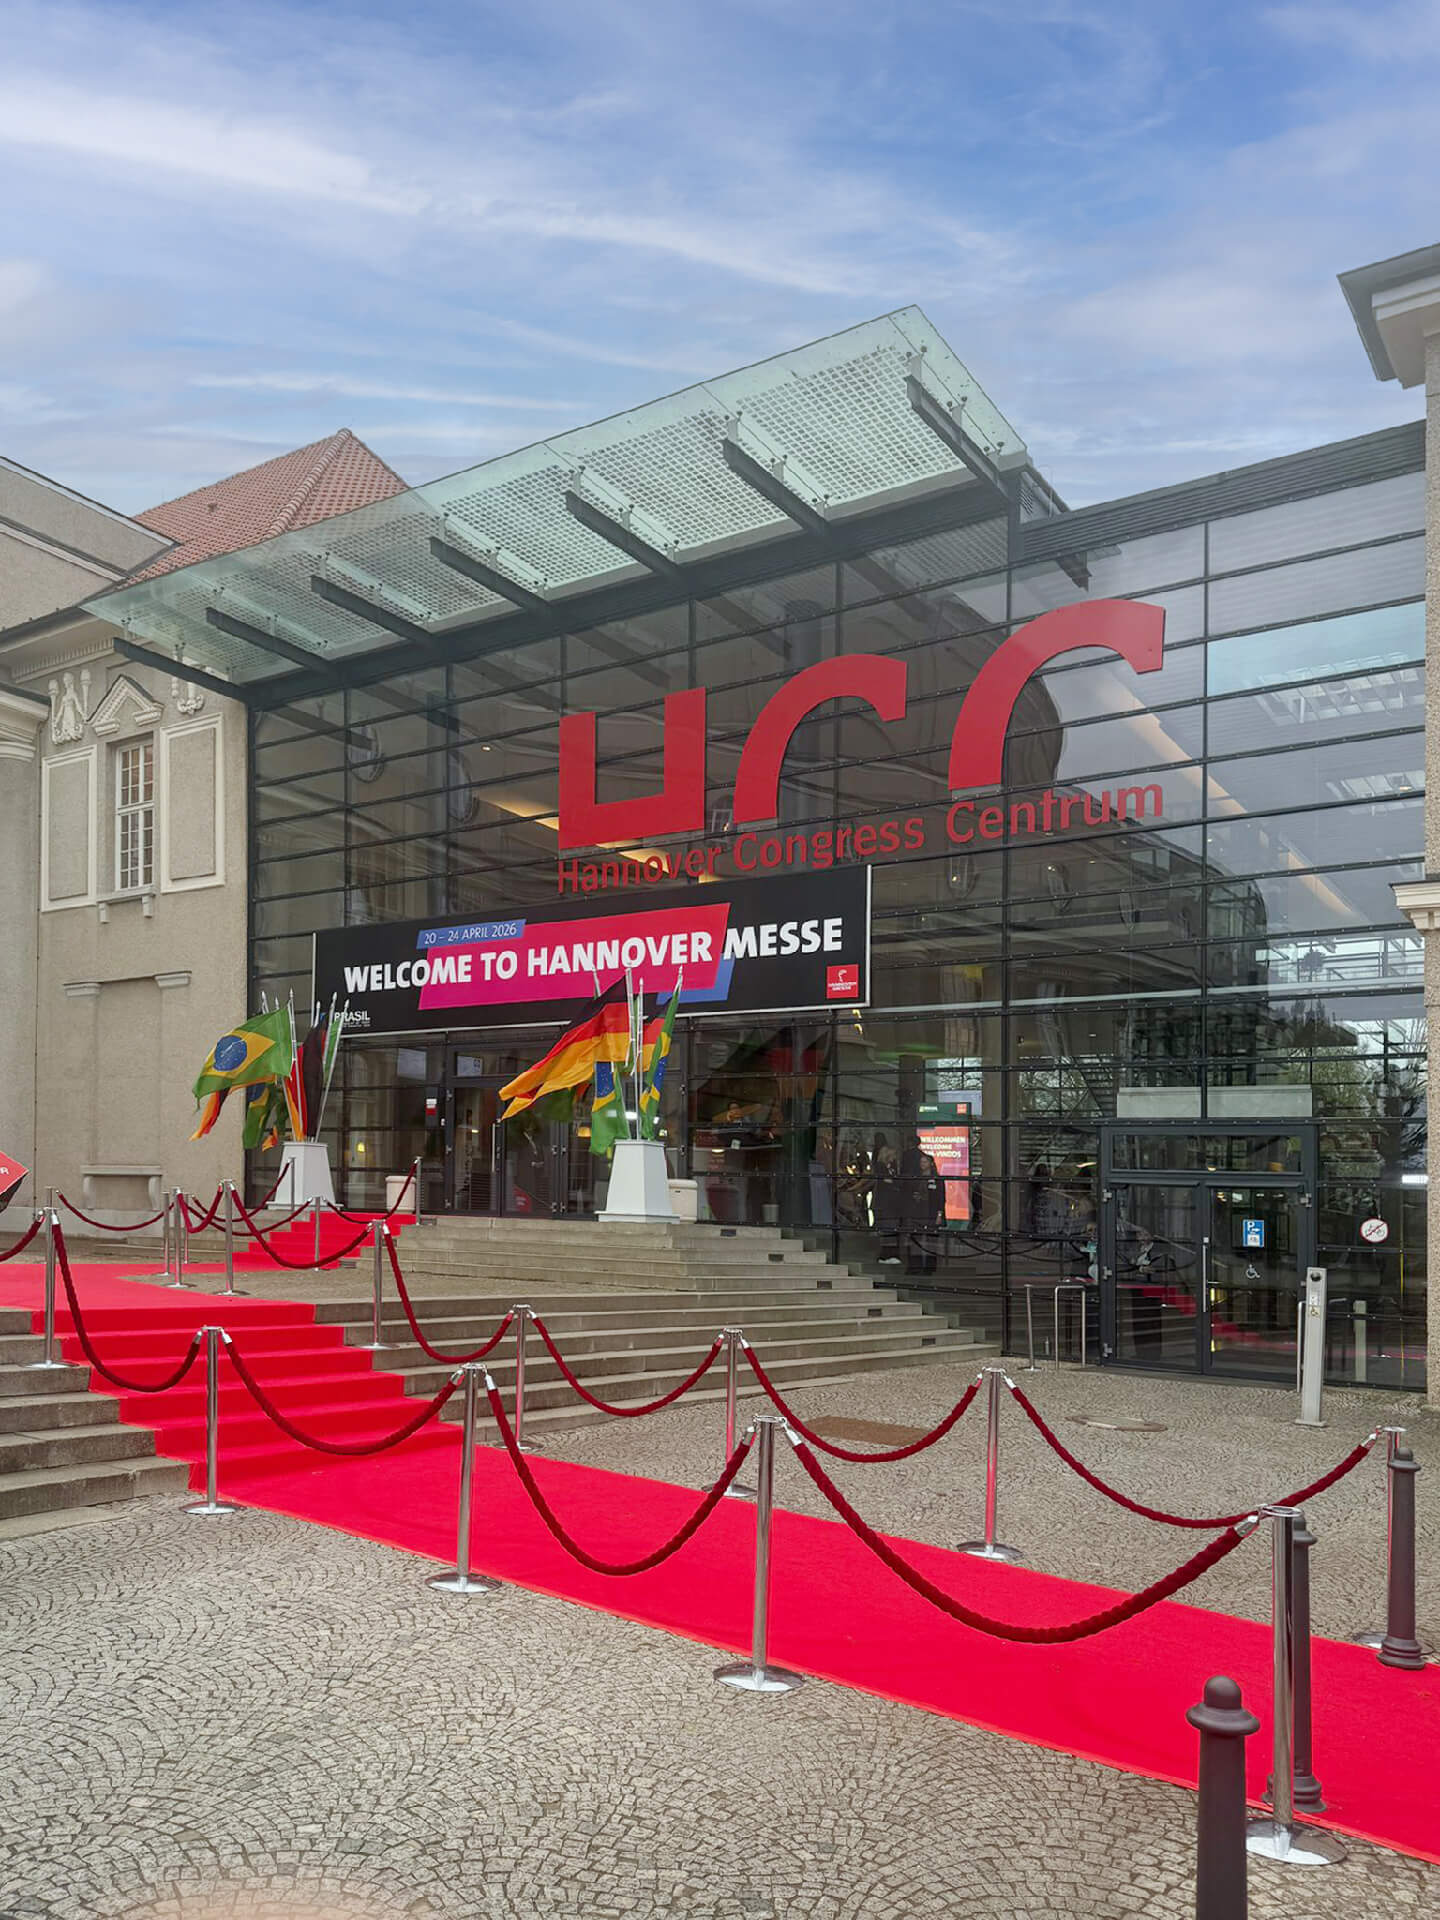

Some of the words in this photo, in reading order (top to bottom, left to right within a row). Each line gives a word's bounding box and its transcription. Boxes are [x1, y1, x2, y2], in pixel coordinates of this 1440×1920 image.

[557, 846, 722, 894] Hannover
[733, 817, 925, 871] Congress
[945, 783, 1163, 844] Centrum
[343, 954, 473, 994] WELCOME
[480, 948, 518, 982] TO
[527, 931, 713, 977] HANNOVER
[723, 917, 844, 959] MESSE
[424, 932, 437, 945] 20
[447, 930, 459, 942] 24
[462, 927, 488, 939] APRIL
[492, 923, 517, 938] 2026
[1247, 1221, 1255, 1231] P
